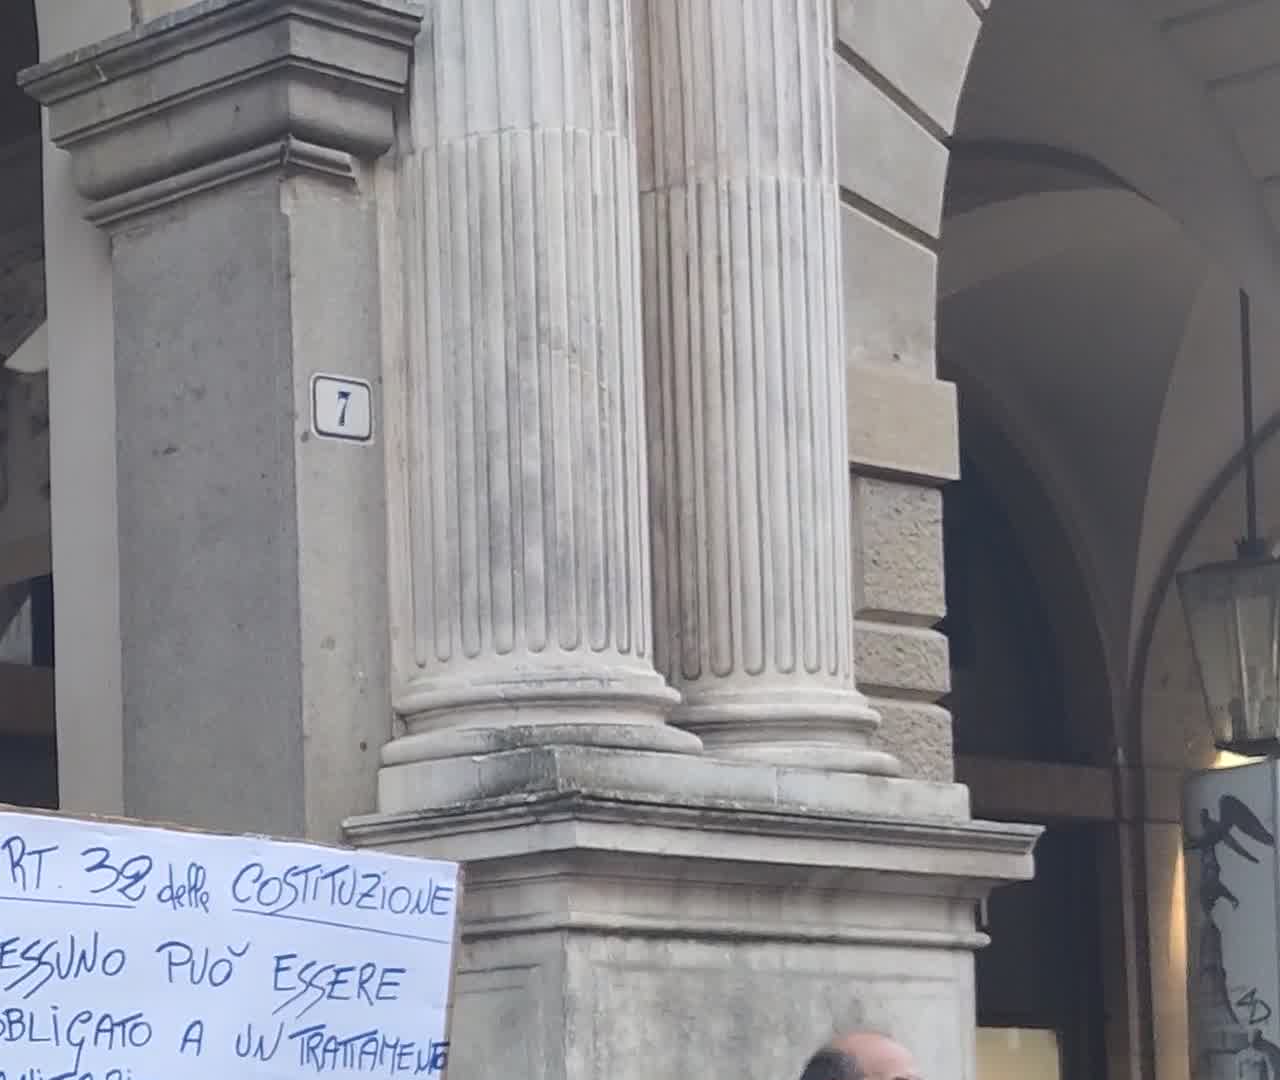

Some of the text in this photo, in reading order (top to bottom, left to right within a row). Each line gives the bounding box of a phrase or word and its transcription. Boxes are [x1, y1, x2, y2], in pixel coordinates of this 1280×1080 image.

[337, 391, 352, 427] 7
[81, 847, 152, 901] 32
[232, 863, 452, 917] COSTITUZIONE
[272, 954, 406, 1018] ESSERE
[181, 1020, 203, 1056] A
[236, 1024, 283, 1061] UN
